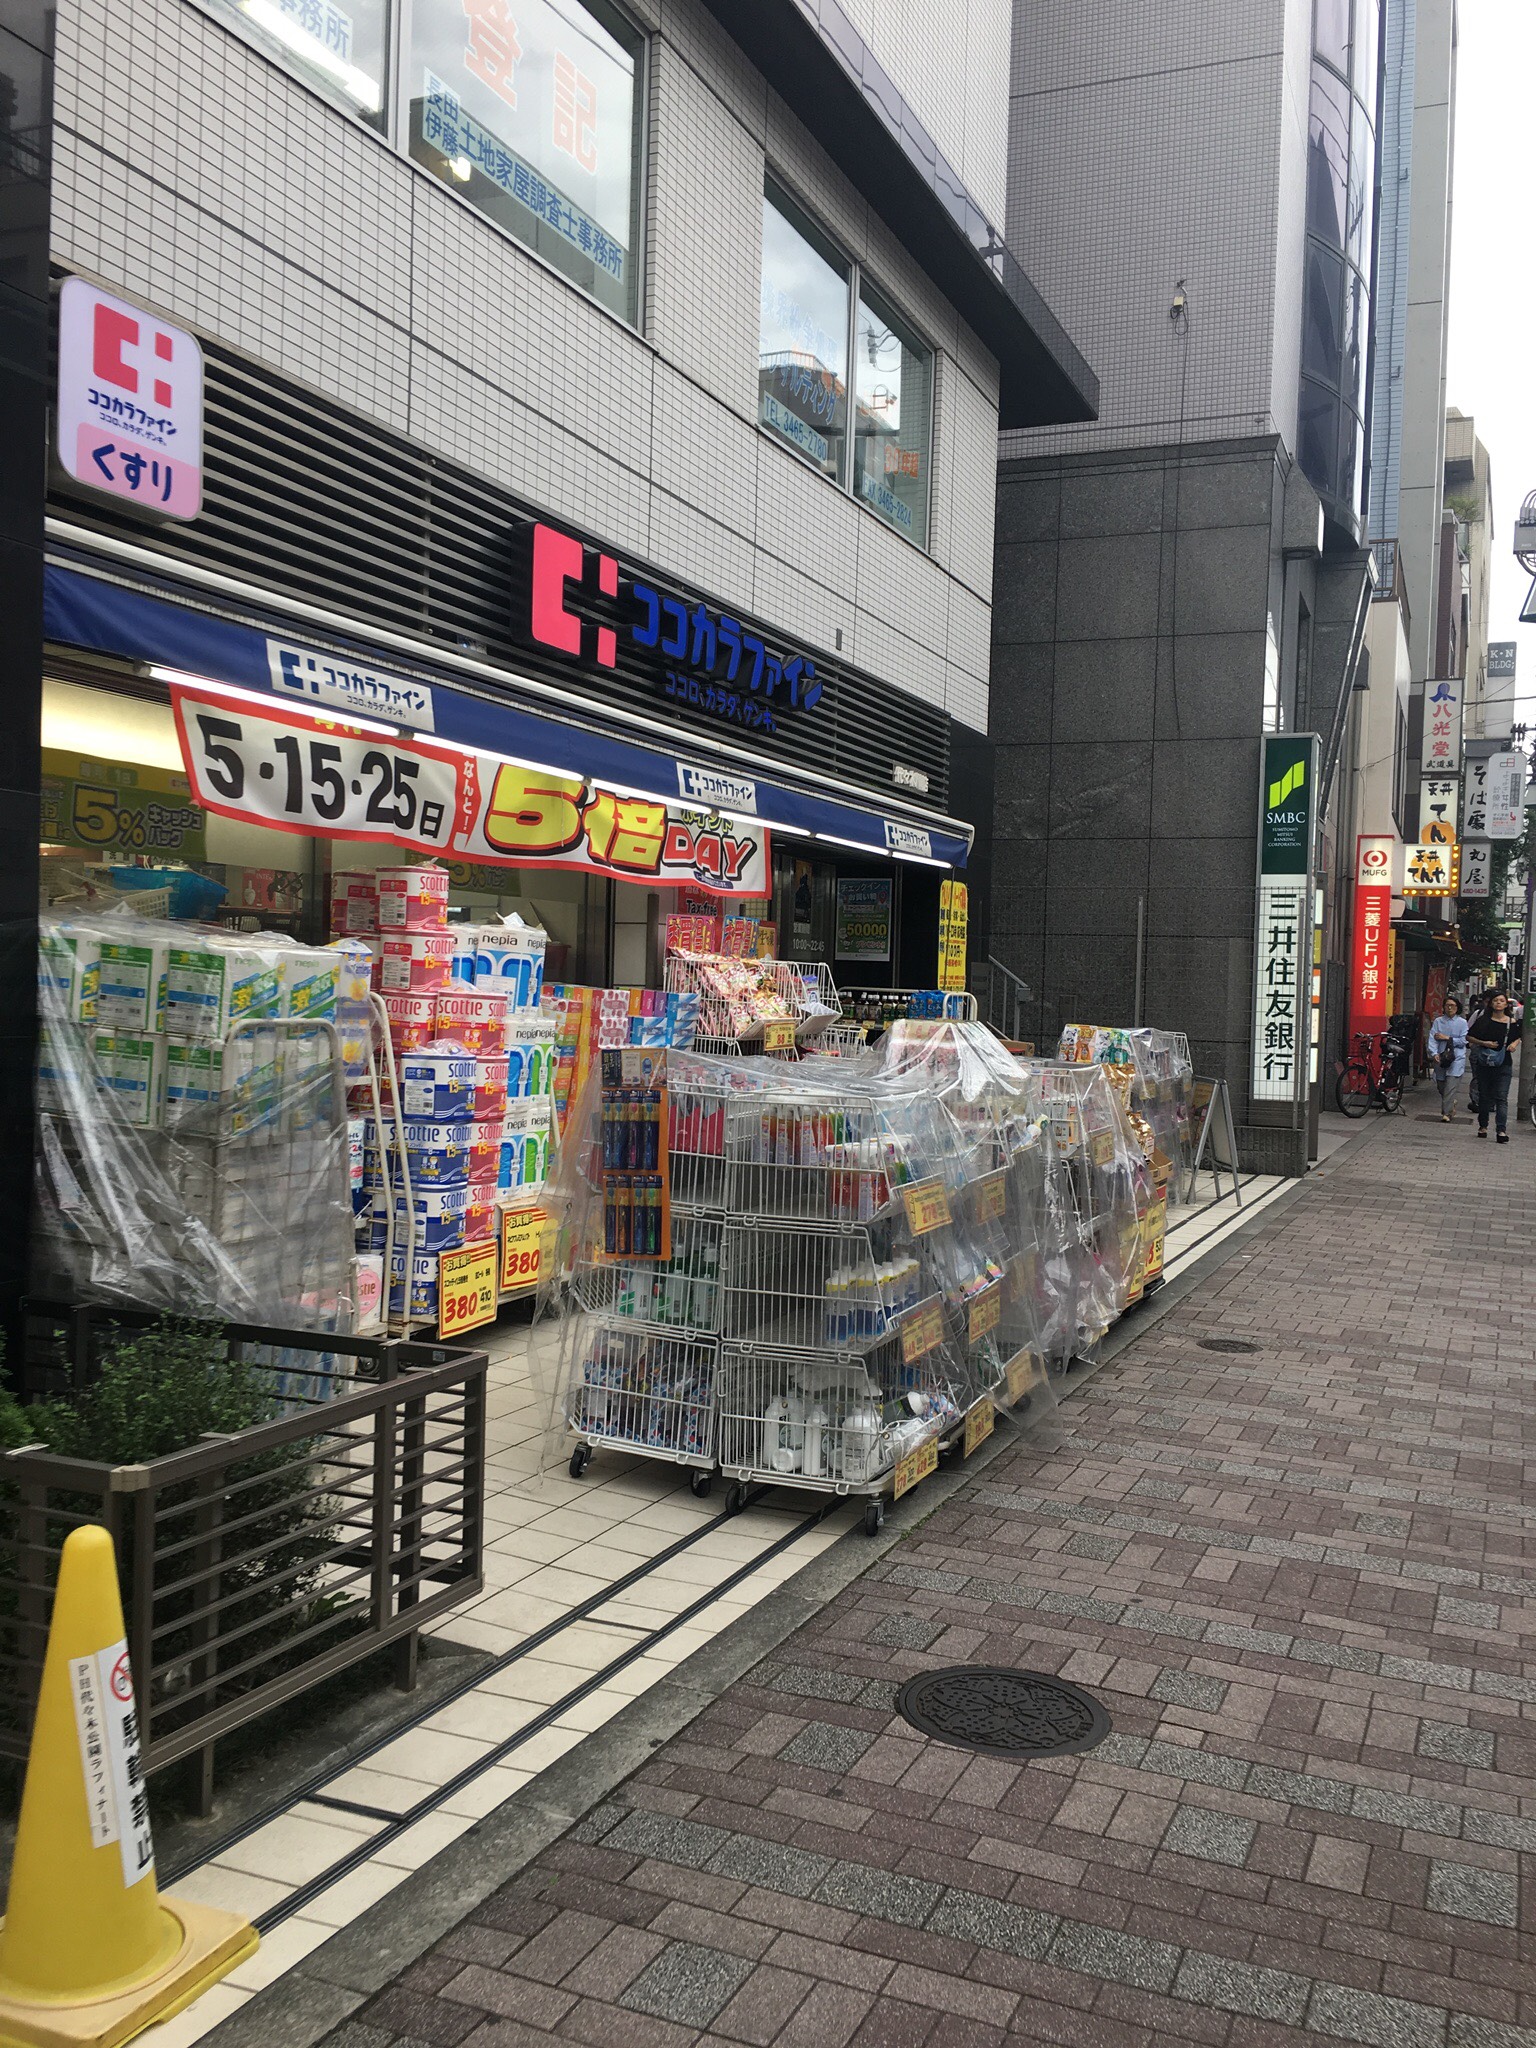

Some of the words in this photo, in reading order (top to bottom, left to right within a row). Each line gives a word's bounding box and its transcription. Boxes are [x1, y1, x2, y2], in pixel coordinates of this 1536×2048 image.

[280, 0, 349, 59] 務所
[88, 388, 177, 436] ココカラファイン
[764, 396, 781, 427] TEL
[92, 443, 173, 502] くすり
[632, 583, 824, 711] ココカラファイン
[322, 666, 425, 711] ココカラファイン
[1431, 703, 1453, 758] 八光堂
[702, 776, 753, 800] ココカラファイン
[73, 783, 147, 849] 5%
[485, 762, 667, 875] 5倍
[1266, 811, 1306, 824] SMBC
[663, 820, 757, 880] DAY
[1361, 869, 1388, 877] MUFG
[1407, 865, 1446, 885] てんや
[686, 899, 718, 918] Tax-free
[482, 934, 518, 946] nepia
[1360, 896, 1382, 1001] 三菱UFJ銀行
[1264, 893, 1298, 1081] 三井住友銀行
[386, 998, 422, 1016] cottie
[506, 1248, 541, 1278] 380
[444, 1291, 478, 1324] 380
[480, 1289, 492, 1303] 410
